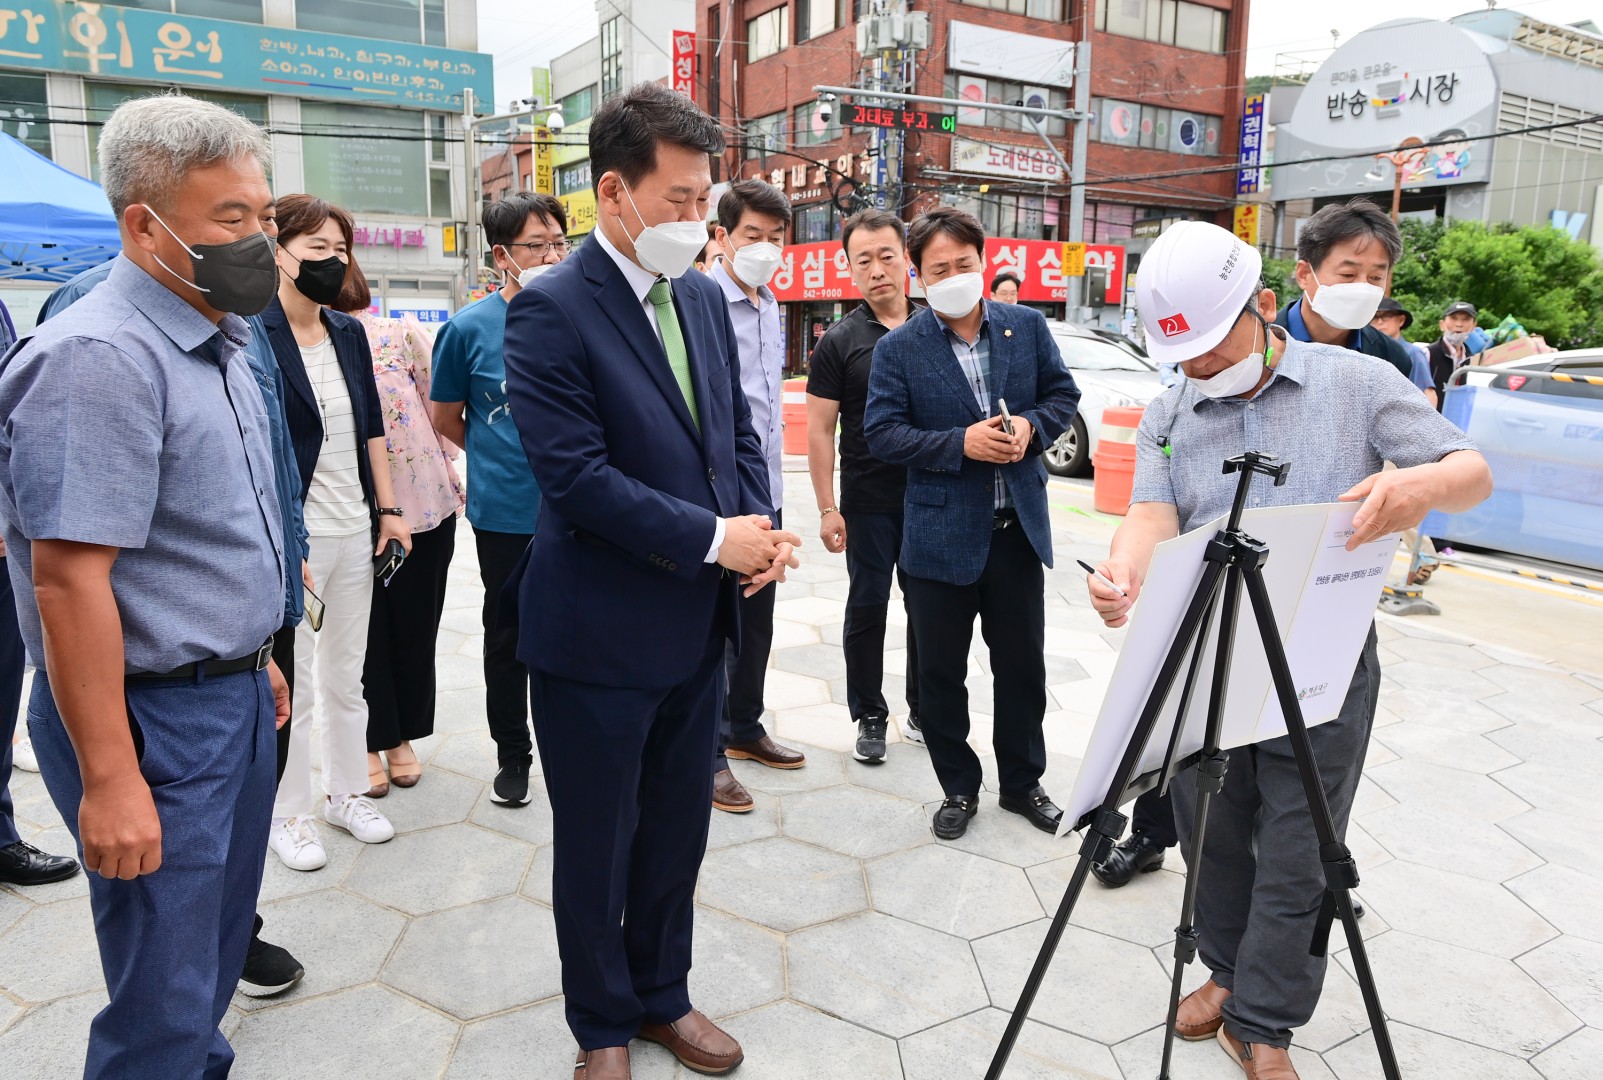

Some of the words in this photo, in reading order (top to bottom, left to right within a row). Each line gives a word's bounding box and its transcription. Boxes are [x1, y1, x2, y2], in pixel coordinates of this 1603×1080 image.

[1327, 89, 1368, 120] 반송
[1409, 72, 1459, 105] 시장
[853, 106, 895, 127] 과태료
[941, 116, 955, 133] 어
[987, 146, 1059, 175] 노래연습장
[803, 288, 842, 298] 542-9000
